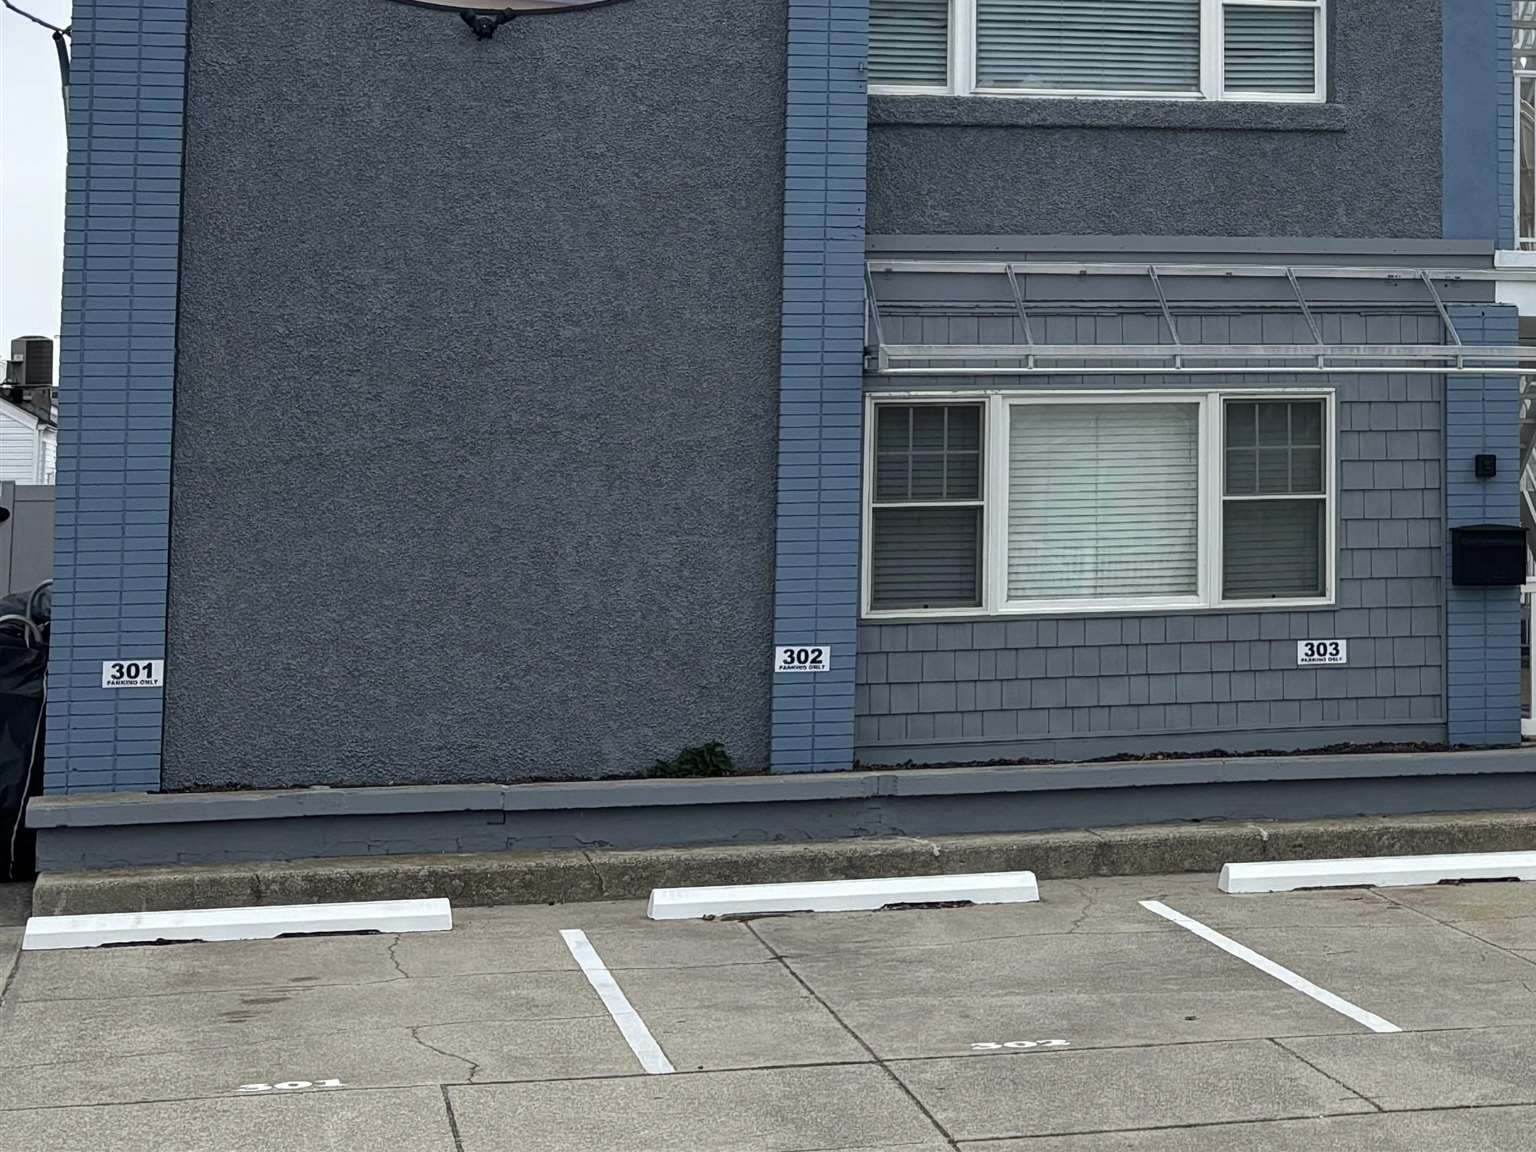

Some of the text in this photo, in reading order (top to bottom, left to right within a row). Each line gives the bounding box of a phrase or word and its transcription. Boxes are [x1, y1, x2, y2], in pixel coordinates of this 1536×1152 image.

[782, 648, 823, 665] 302
[1304, 641, 1340, 657] 303
[110, 662, 153, 680] 301
[237, 1079, 346, 1091] 301
